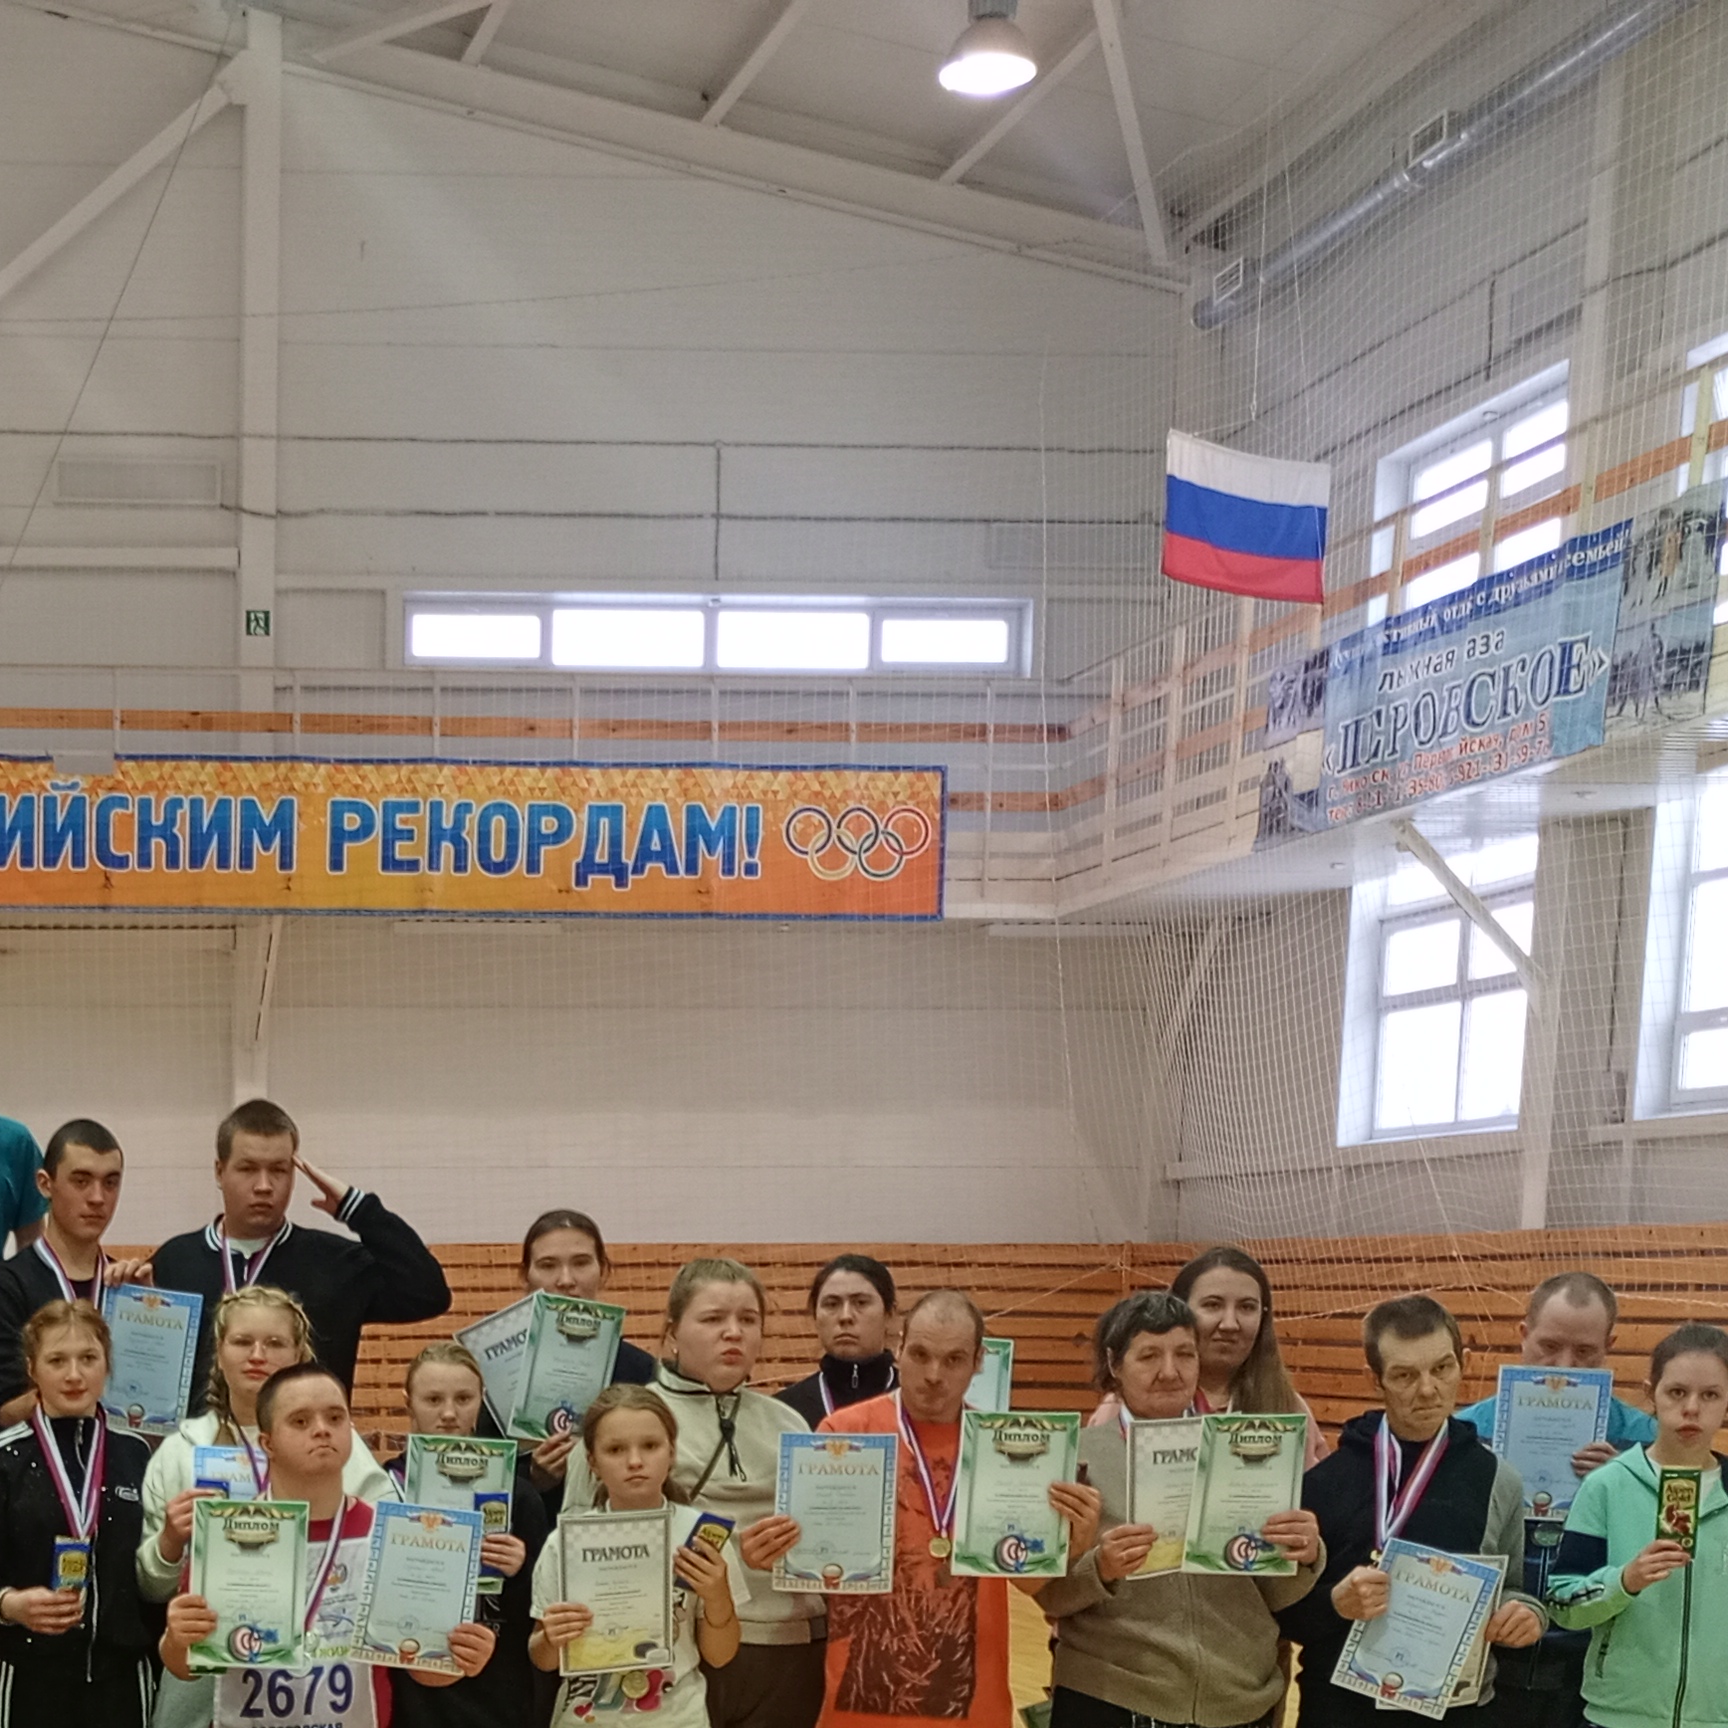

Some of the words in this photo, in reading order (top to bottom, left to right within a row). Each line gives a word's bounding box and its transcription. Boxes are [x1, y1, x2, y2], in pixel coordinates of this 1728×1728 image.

[325, 797, 764, 891] РЕКОРДАМ!
[118, 1310, 184, 1331] ГРАМОТА
[484, 1328, 529, 1362] ГРАМО
[1516, 1394, 1595, 1412] ГРАМОТА
[992, 1428, 1051, 1444] Диплом
[1227, 1432, 1283, 1446] Диплом
[437, 1452, 489, 1469] Диплом
[1152, 1447, 1198, 1465] ГРАМ
[210, 1470, 253, 1485] ГРАМ
[797, 1462, 880, 1477] ГРАМОТА
[222, 1517, 280, 1532] Диплом
[389, 1532, 467, 1553] ГРАМОТА
[581, 1543, 651, 1563] ГРАМОТА
[1393, 1569, 1473, 1604] ГРАМОТА
[238, 1664, 355, 1719] 2679
